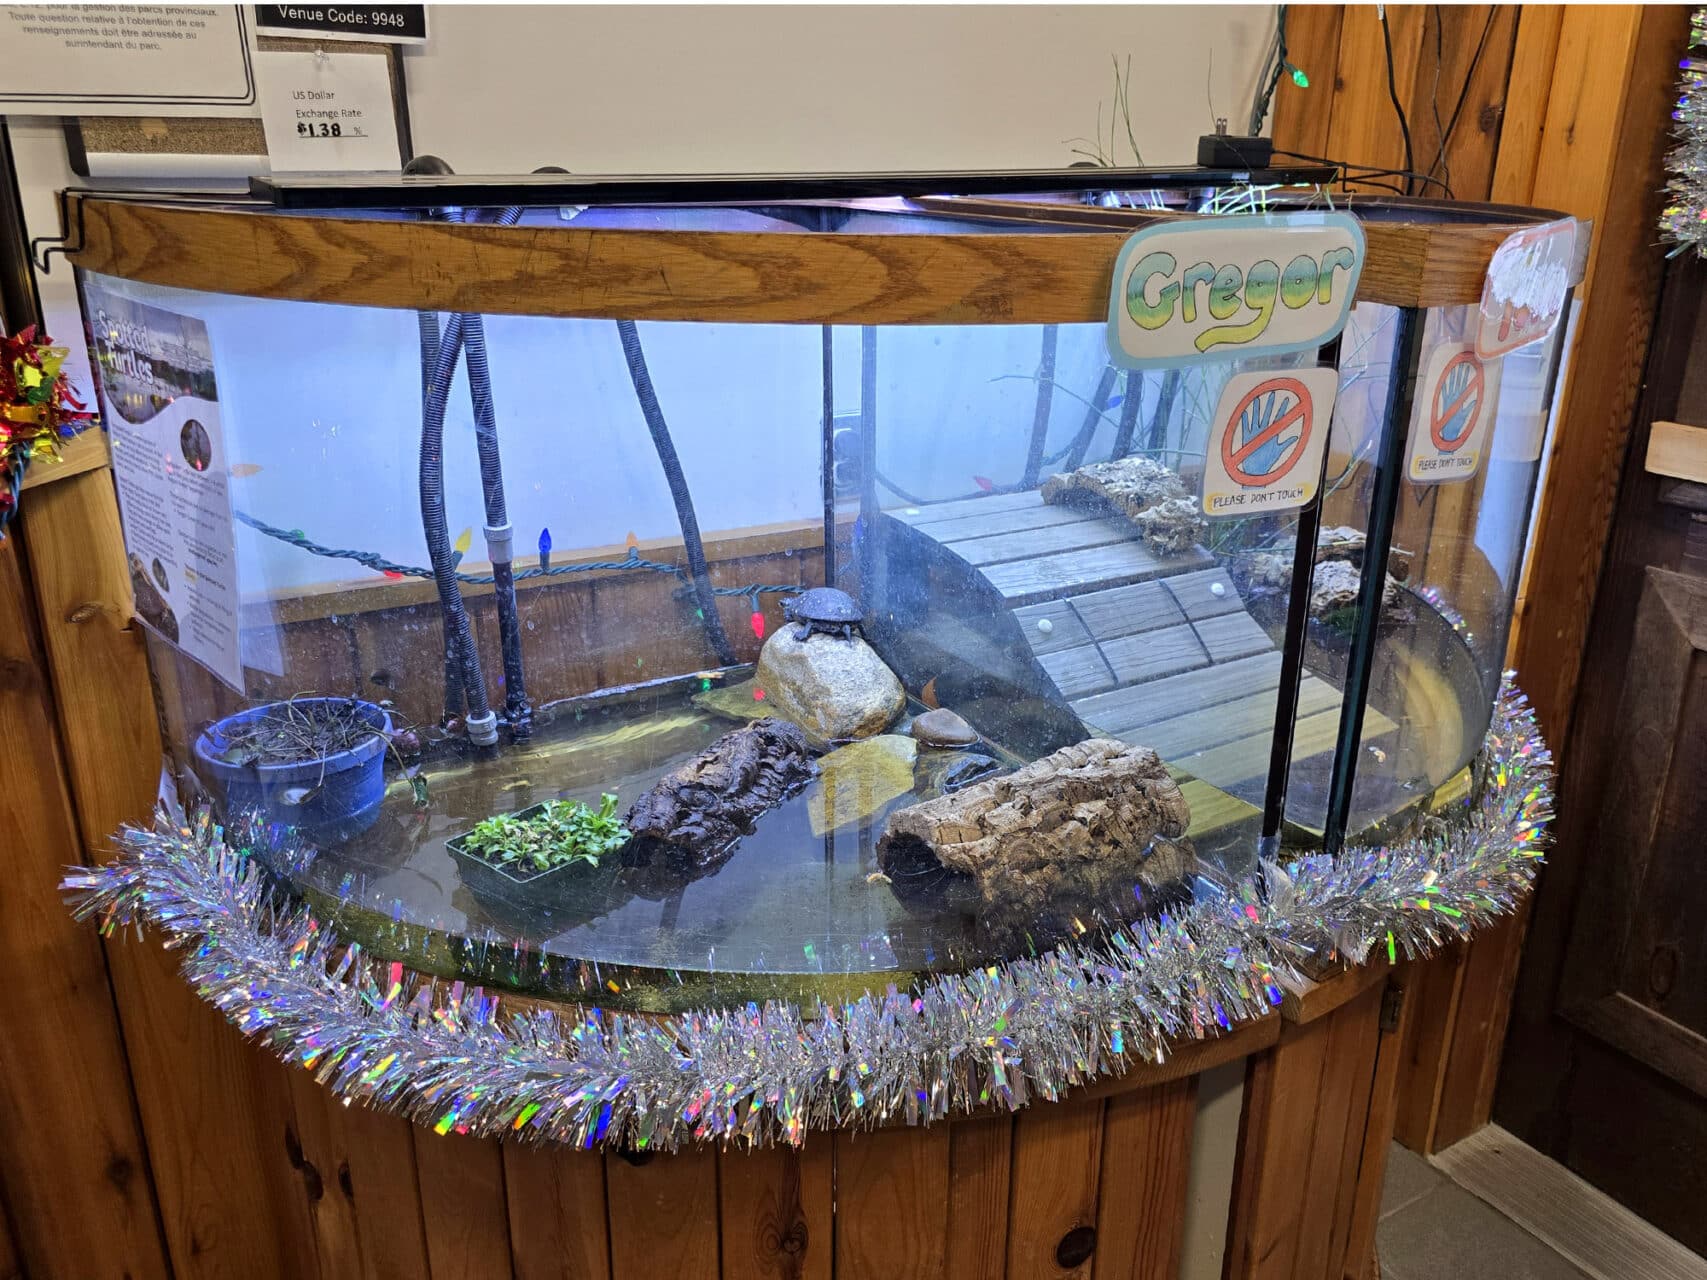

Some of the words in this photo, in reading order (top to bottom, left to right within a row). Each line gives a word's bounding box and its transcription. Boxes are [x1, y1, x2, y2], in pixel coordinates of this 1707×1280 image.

[82, 5, 117, 13] gestion
[119, 5, 136, 13] des
[138, 6, 164, 15] parcs
[165, 7, 219, 17] provinciaux.
[277, 4, 324, 21] Venue
[327, 8, 368, 24] Code:
[371, 12, 405, 28] 9948
[8, 11, 36, 21] Toute
[39, 14, 80, 24] question
[82, 14, 116, 24] relative
[176, 18, 187, 27] de
[189, 20, 206, 28] ces
[22, 25, 100, 36] renseignements
[102, 27, 119, 37] doit
[121, 28, 139, 38] être
[141, 29, 183, 39] adressée
[185, 32, 197, 40] au
[65, 39, 124, 50] surintendant
[126, 41, 137, 50] du
[139, 42, 162, 52] parc.
[292, 90, 306, 100] US
[307, 90, 335, 100] Dollar
[295, 109, 339, 120] Exchange
[341, 109, 362, 118] Rate
[296, 121, 341, 137] $1.38
[1126, 246, 1355, 352] Gregor
[99, 309, 152, 358] Spotted
[104, 339, 154, 386] Turtles
[1213, 494, 1246, 509] PLEASE
[1278, 488, 1304, 500] TOUCH
